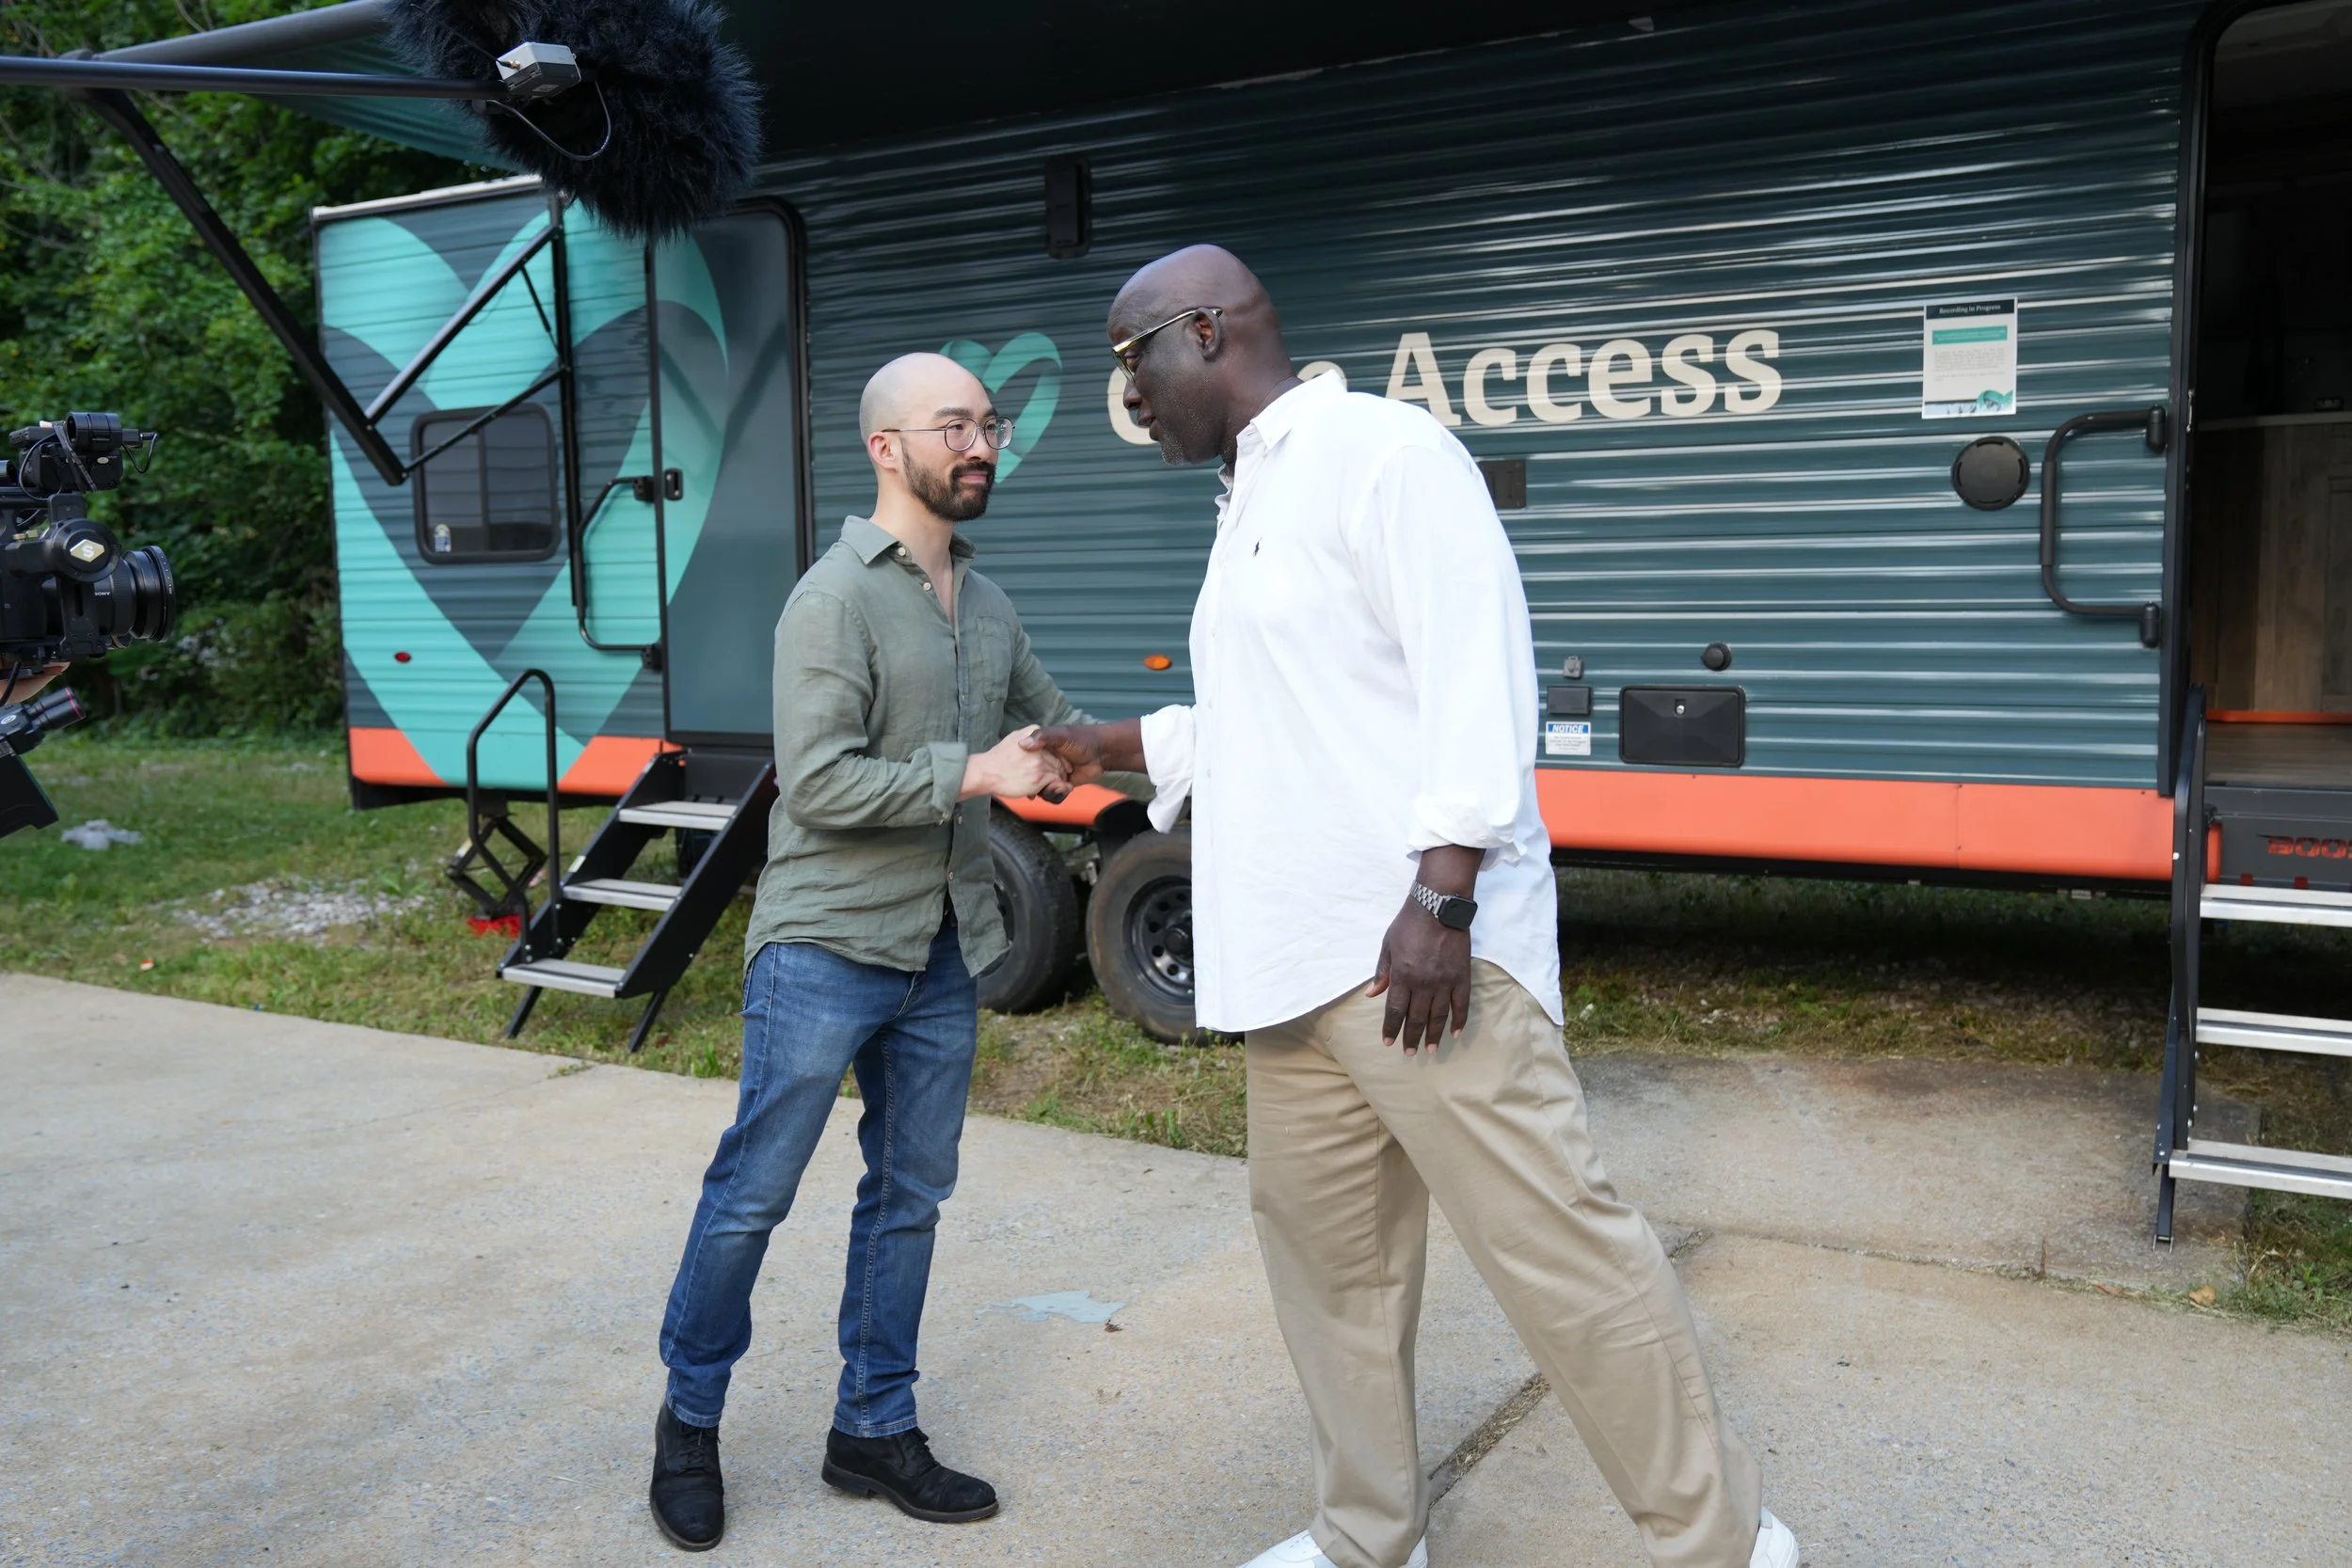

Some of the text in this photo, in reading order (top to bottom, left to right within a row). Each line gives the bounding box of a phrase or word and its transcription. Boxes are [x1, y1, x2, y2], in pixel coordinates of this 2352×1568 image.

[1939, 306, 1968, 314] Recording
[1976, 304, 2001, 312] Progress
[1385, 329, 1783, 427] Access
[1552, 723, 1584, 734] NOTICE
[2268, 835, 2352, 860] BOO
